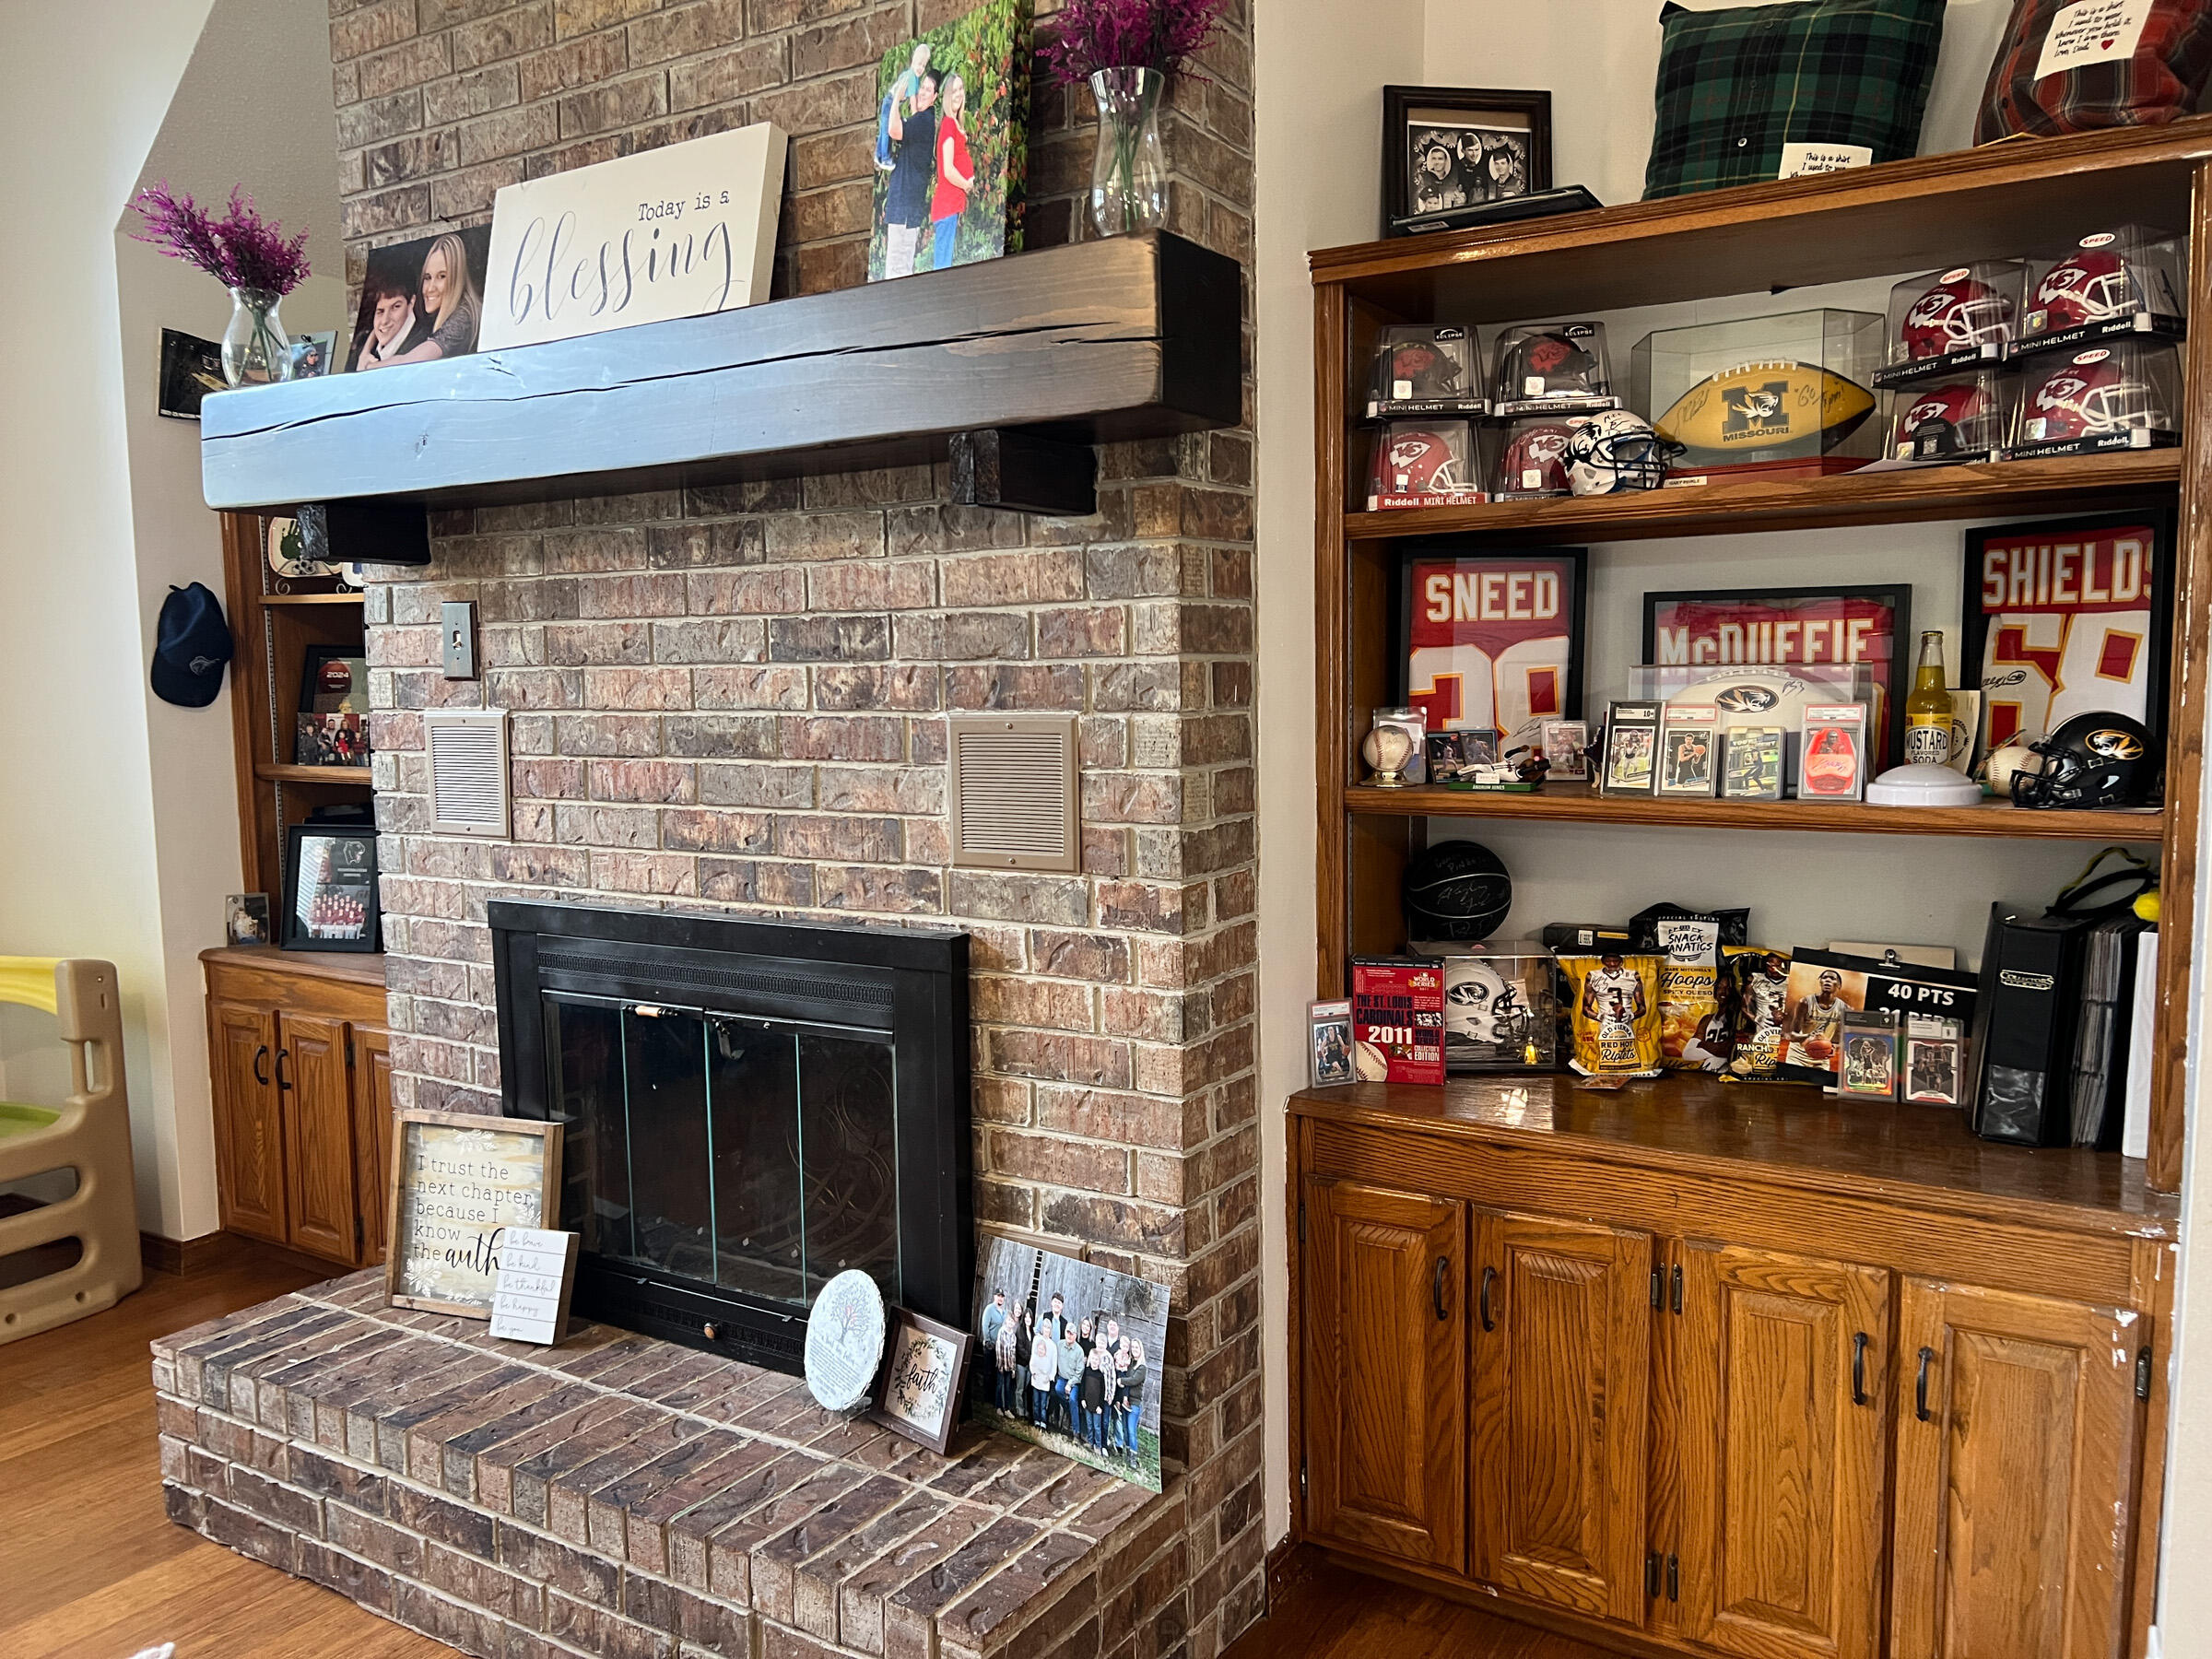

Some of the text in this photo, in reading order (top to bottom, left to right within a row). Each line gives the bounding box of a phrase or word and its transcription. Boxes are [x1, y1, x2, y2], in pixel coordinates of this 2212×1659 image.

[1806, 152, 1819, 161] This
[638, 189, 730, 222] Today is a
[2082, 234, 2112, 245] SPEED
[510, 211, 745, 325] blessing
[2021, 321, 2132, 351] MINI HELMET Riddell
[2077, 350, 2108, 362] SPEED
[1883, 353, 1977, 381] MINI HELMET Riddell
[1457, 403, 1482, 411] Riddell
[1535, 403, 1572, 411] HELMET
[1586, 401, 1611, 409] Riddell
[1723, 426, 1789, 442] MISSOURI
[2015, 435, 2129, 459] MINI HELMET Riddell
[1384, 495, 1477, 507] Riddell MINI HELMET
[1983, 537, 2154, 608] SHIELD
[1425, 570, 1559, 624] SNEED
[1667, 942, 1713, 953] ANATICS
[1668, 934, 1703, 945] SNACK
[1660, 971, 1714, 989] Hoops
[1357, 994, 1371, 1007] THE
[1387, 995, 1413, 1009] LOUIS
[1888, 983, 1955, 1006] 40 PTS
[1356, 1008, 1413, 1027] CARDINALS
[1368, 1025, 1413, 1044] 2011
[1602, 1027, 1614, 1039] OLD
[1414, 1052, 1440, 1062] EDITION
[418, 1155, 509, 1181] I trust the
[418, 1180, 456, 1196] next
[417, 1197, 500, 1224] because I
[415, 1218, 461, 1239] know
[510, 1230, 520, 1245] be
[414, 1243, 441, 1261] the
[506, 1253, 517, 1268] be
[503, 1273, 514, 1288] be
[500, 1294, 511, 1310] be
[497, 1316, 507, 1333] be
[904, 1363, 939, 1394] faith
